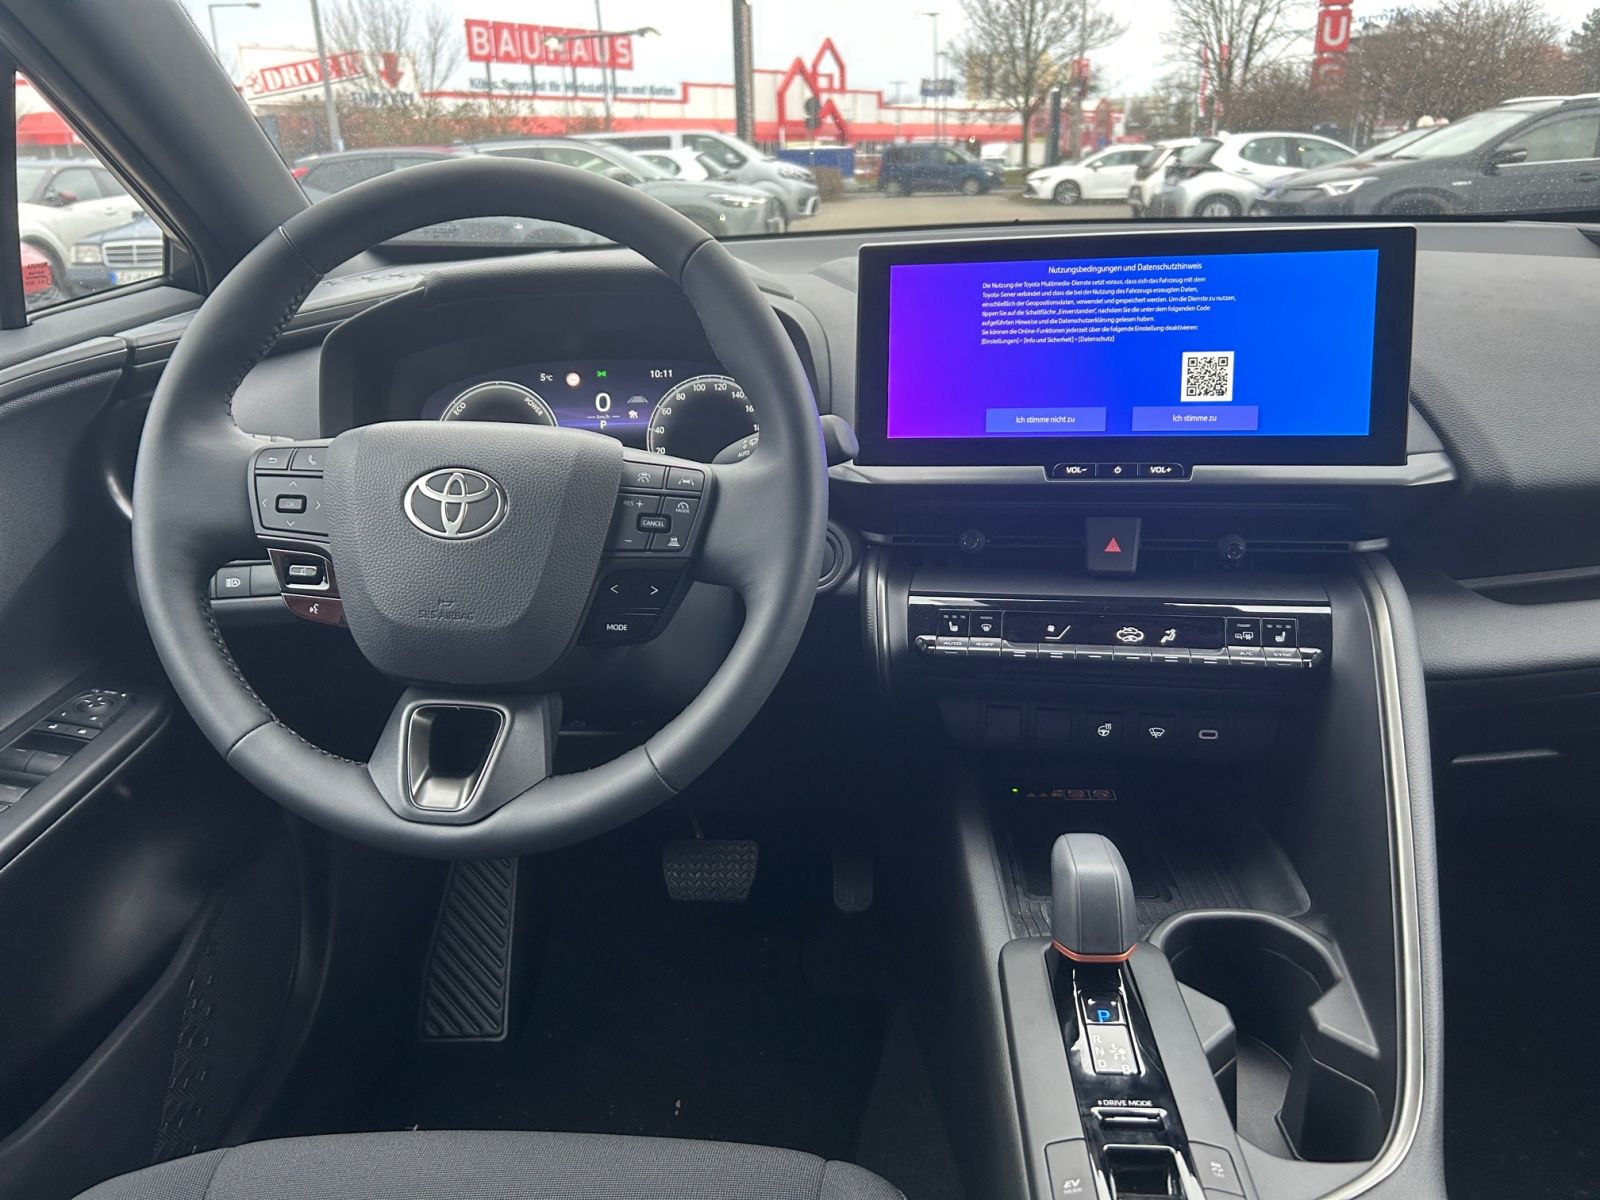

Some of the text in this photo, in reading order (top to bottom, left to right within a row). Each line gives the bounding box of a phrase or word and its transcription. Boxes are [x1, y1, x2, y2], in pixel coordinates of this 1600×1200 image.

[1048, 265, 1122, 274] Nutzungsbedingungen
[1138, 263, 1202, 271] Datenschutzhinweis
[1092, 288, 1115, 296] Nutzung
[1126, 287, 1152, 295] Fahrzeugs
[650, 369, 673, 379] 10:11
[692, 383, 706, 392] 100
[713, 383, 728, 391] 120
[676, 392, 686, 400] 80
[731, 391, 745, 399] 140
[595, 392, 611, 412] 0
[453, 401, 467, 416] ECO
[524, 397, 544, 417] POWER
[662, 407, 672, 415] 60
[745, 404, 755, 413] 16
[1016, 415, 1025, 423] Ich
[1027, 415, 1049, 423] stimme
[1050, 415, 1065, 423] nicht
[1172, 414, 1182, 422] Ich
[1184, 414, 1207, 422] stimme
[600, 420, 607, 429] P
[655, 426, 665, 435] 40
[655, 446, 666, 455] 20
[1150, 466, 1172, 474] VOL+
[642, 519, 665, 527] CANCEL
[606, 623, 628, 631] MODE
[1097, 1009, 1111, 1023] P
[1093, 1035, 1101, 1043] R
[1095, 1047, 1105, 1056] N
[1098, 1060, 1107, 1068] D
[1122, 1064, 1131, 1075] B
[1063, 1178, 1080, 1188] EV
